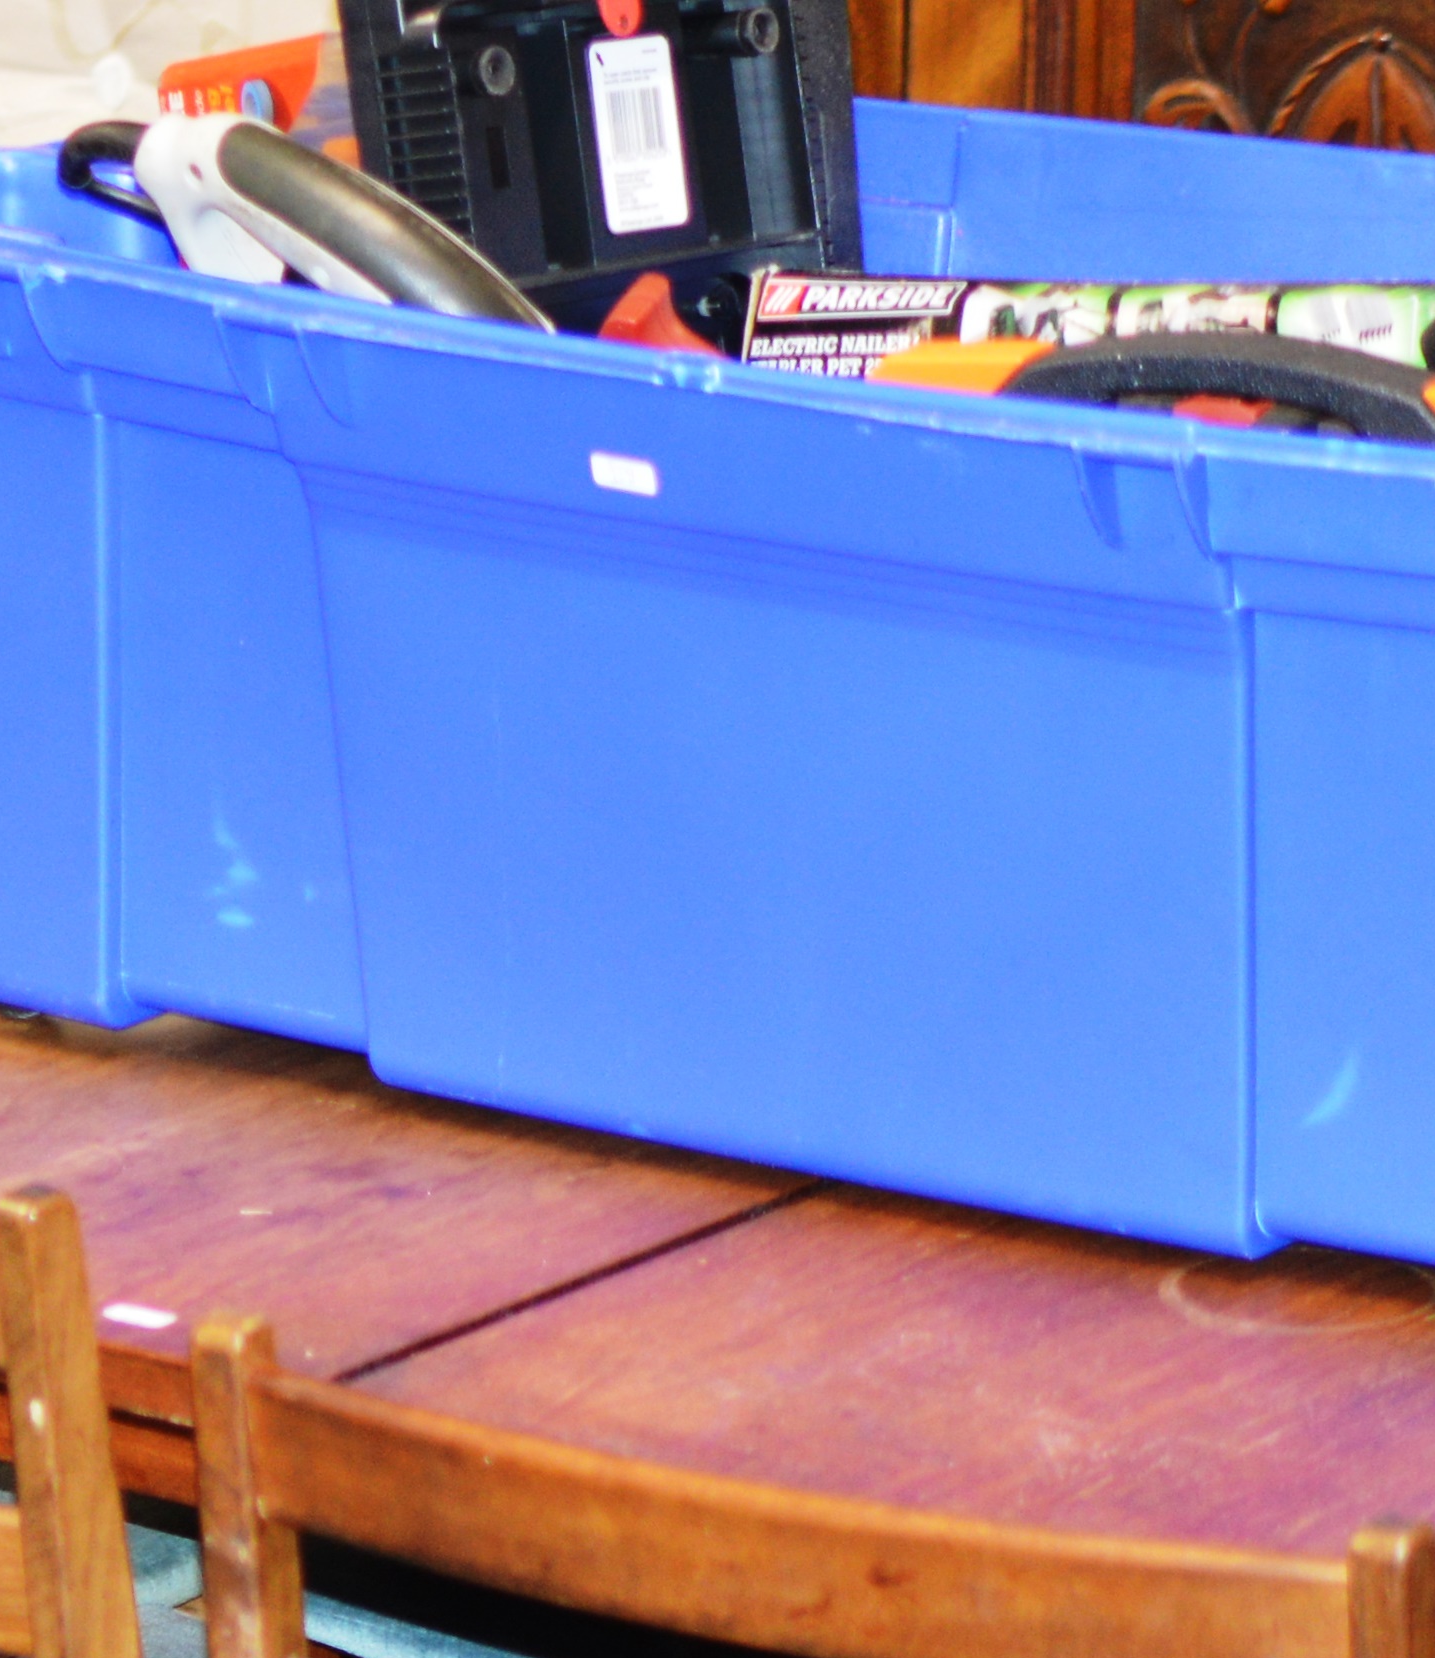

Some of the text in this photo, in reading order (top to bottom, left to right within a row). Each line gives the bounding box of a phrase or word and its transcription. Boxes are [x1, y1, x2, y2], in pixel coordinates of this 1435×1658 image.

[801, 285, 954, 312] PARKSIDE
[750, 334, 838, 357] ELECTRIC
[827, 357, 863, 377] PET
